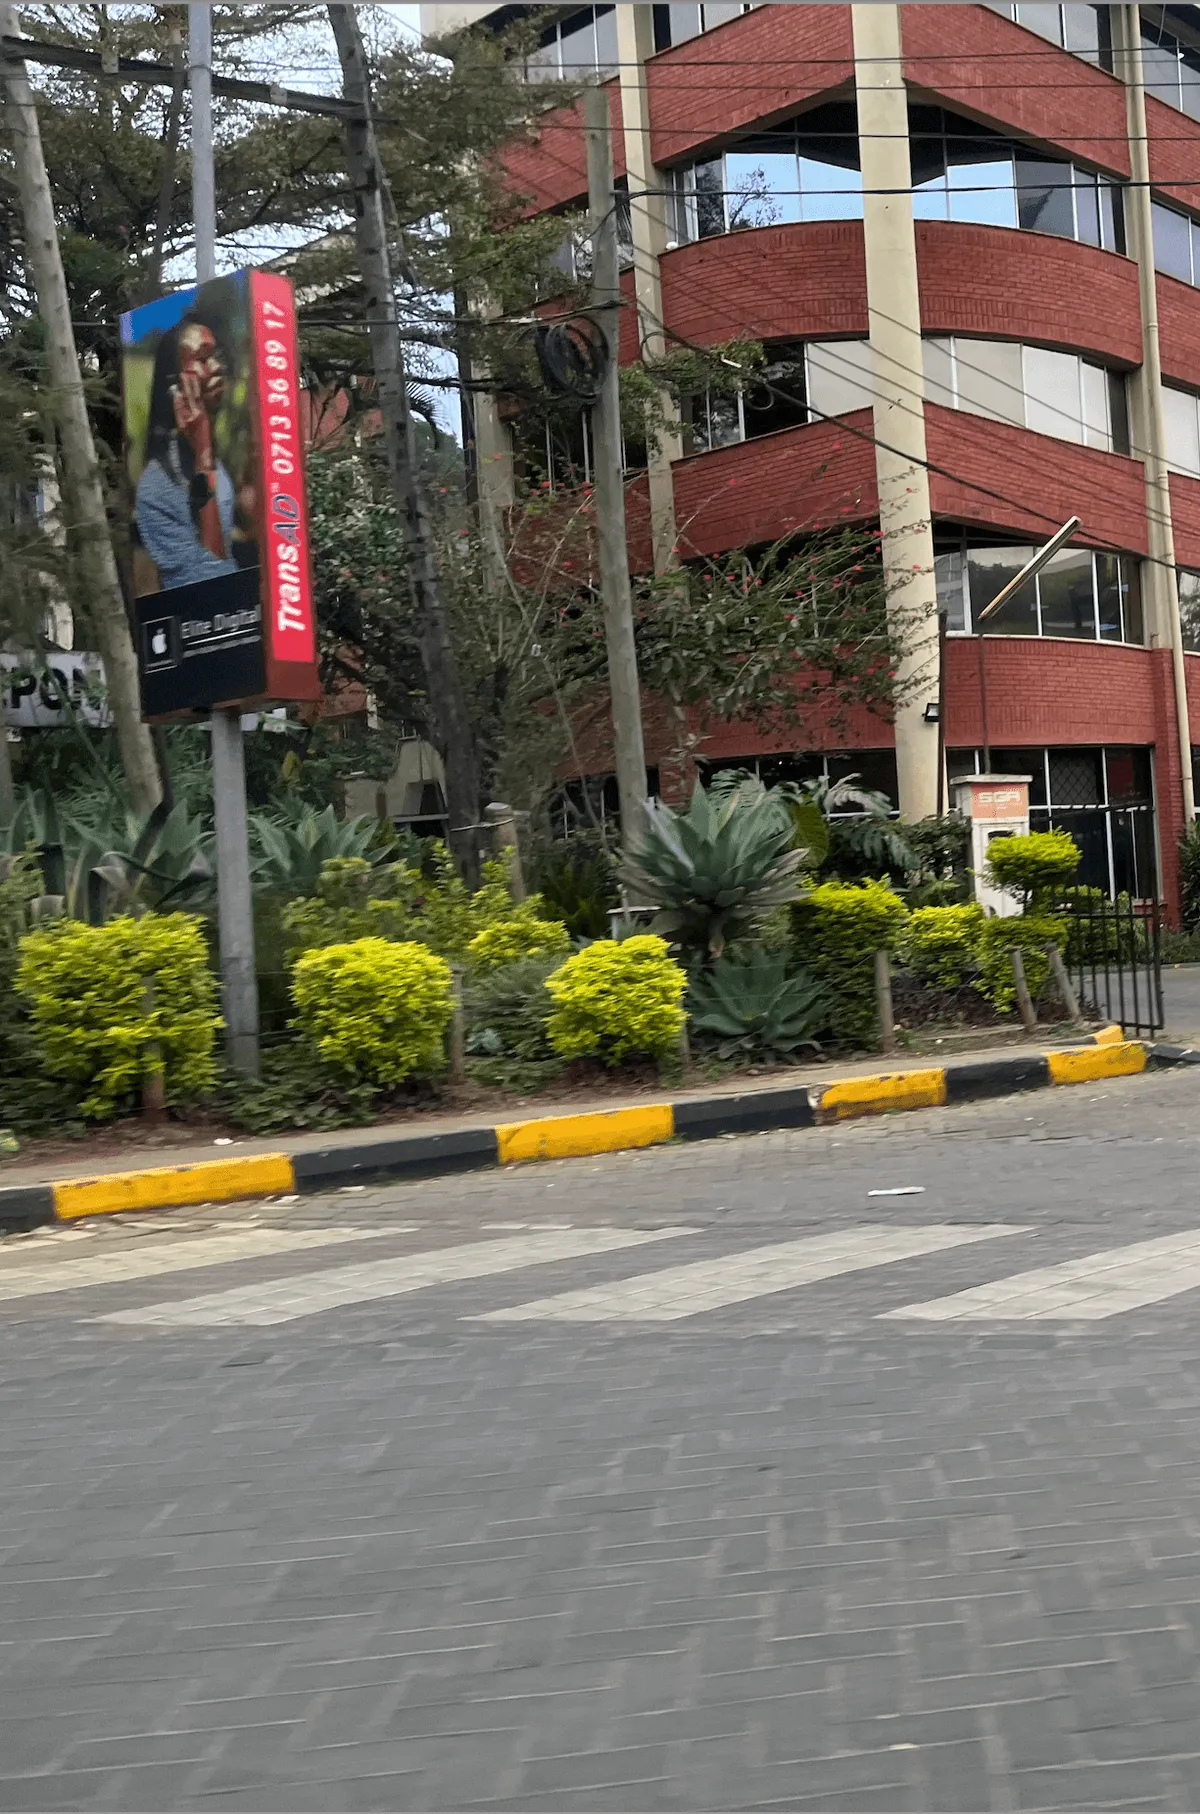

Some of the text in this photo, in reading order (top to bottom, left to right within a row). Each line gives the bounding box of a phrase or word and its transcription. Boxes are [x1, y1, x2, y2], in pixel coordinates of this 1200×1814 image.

[262, 301, 287, 329] 17
[264, 339, 288, 371] 89
[267, 377, 291, 407] 36
[269, 415, 295, 475] 0713
